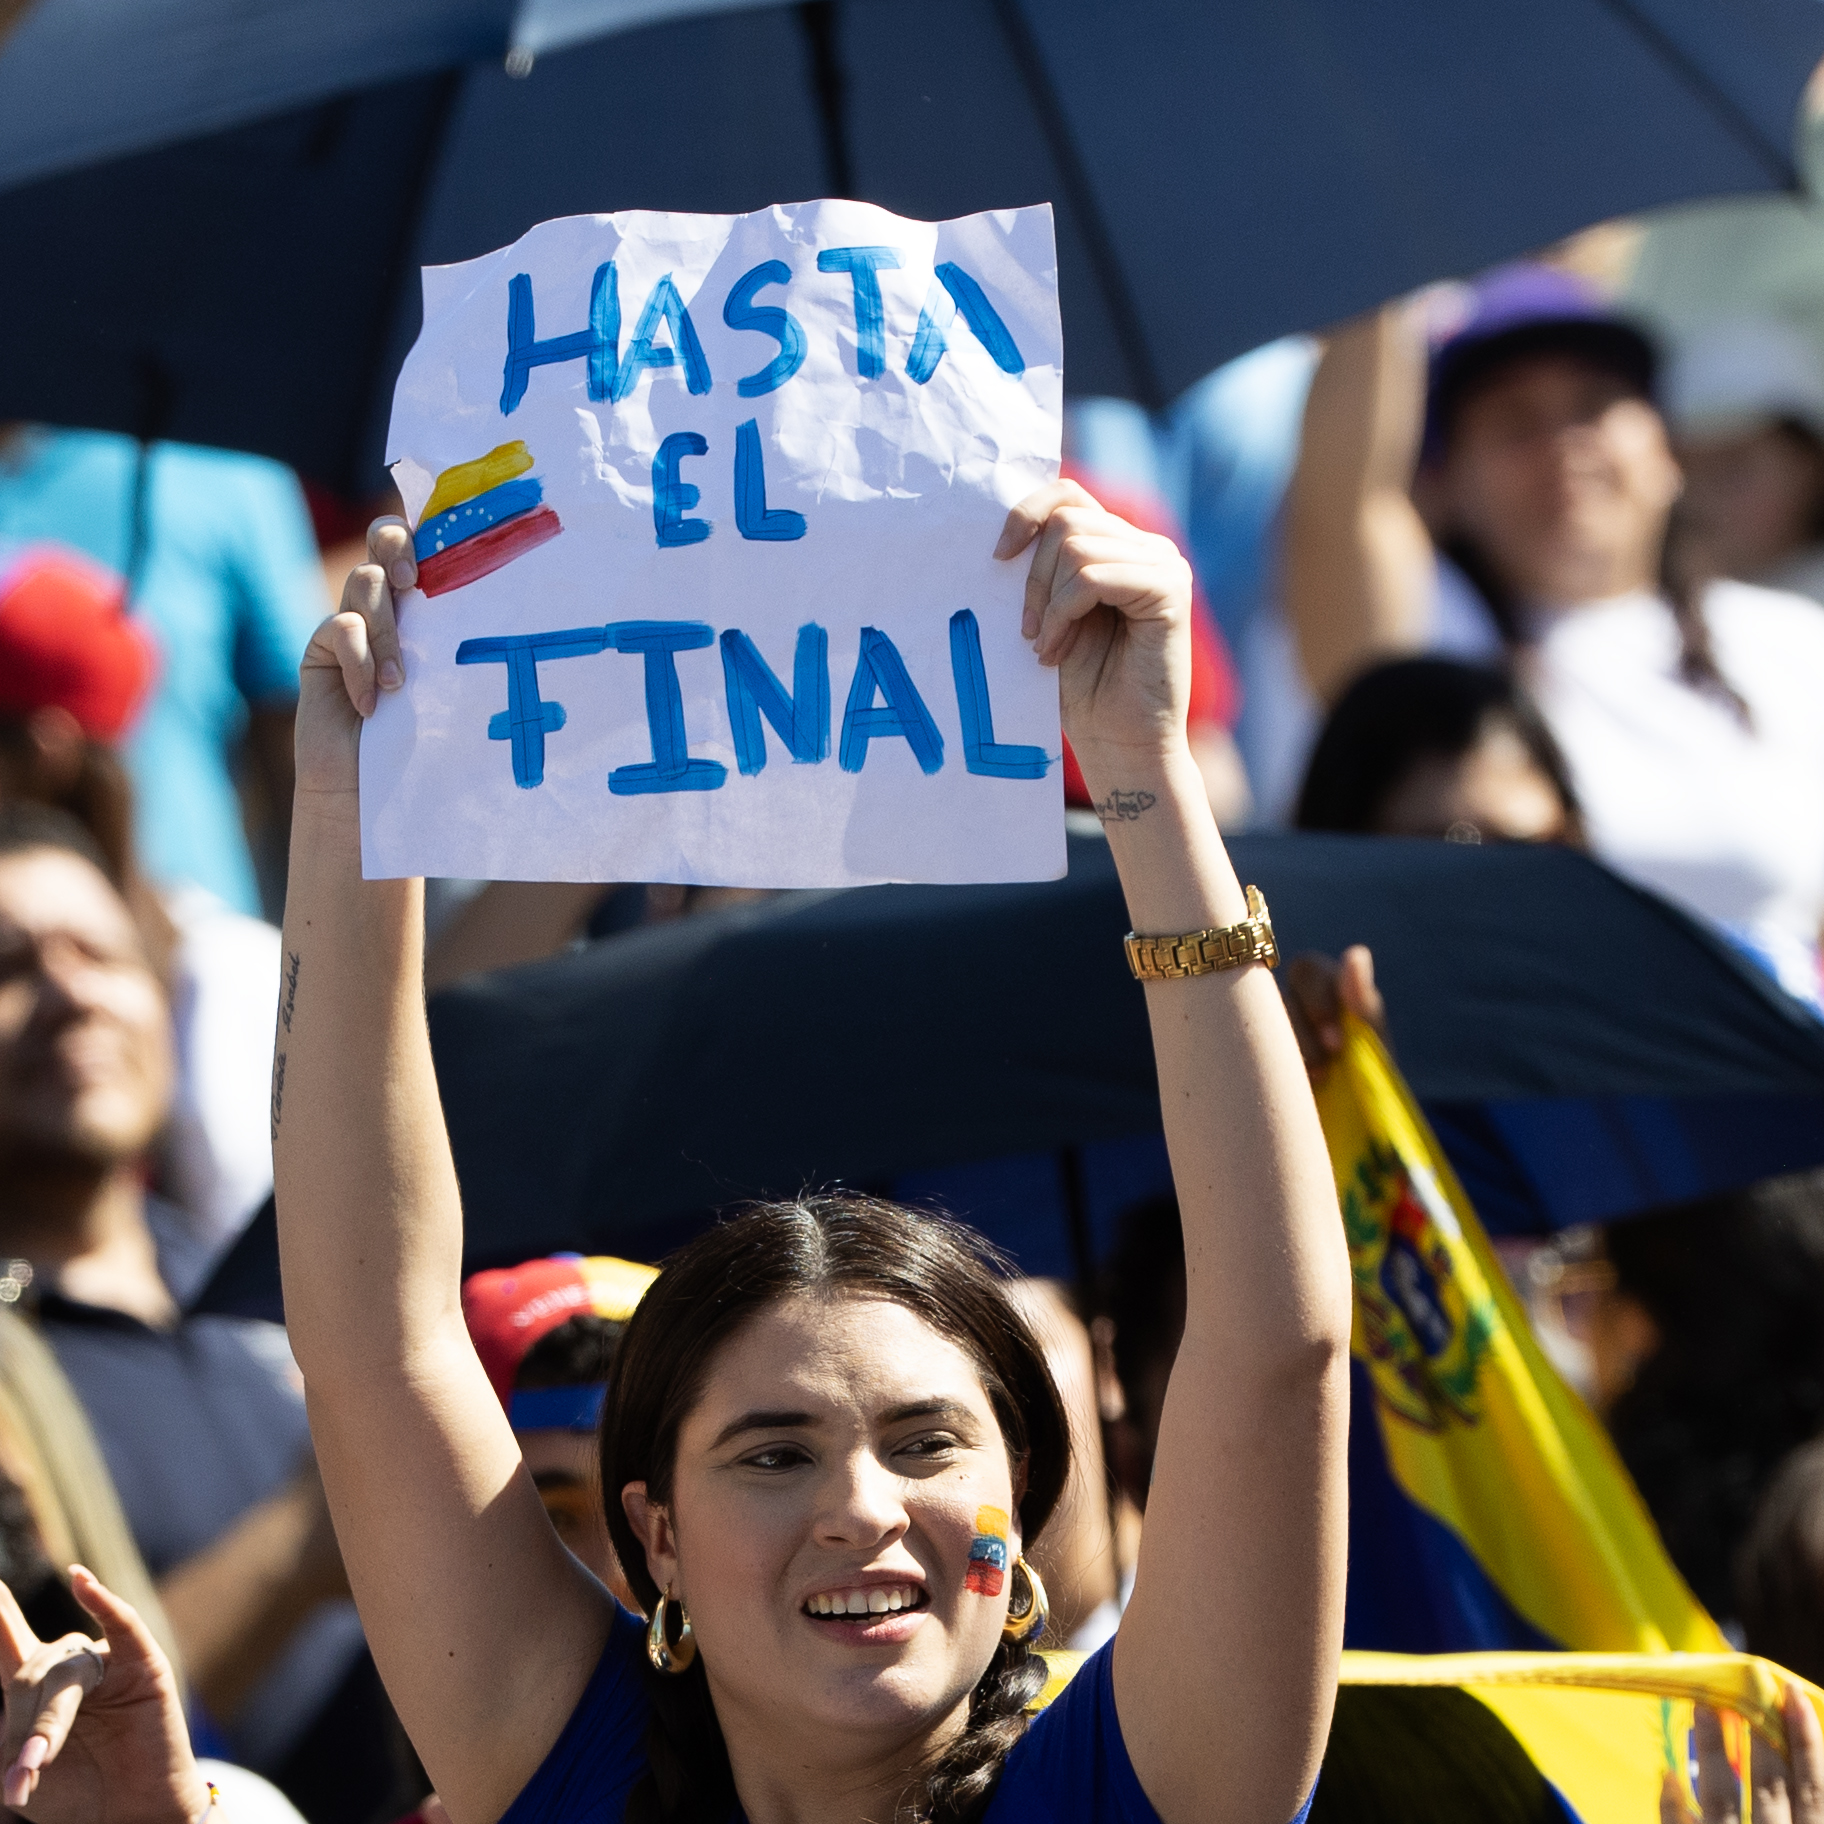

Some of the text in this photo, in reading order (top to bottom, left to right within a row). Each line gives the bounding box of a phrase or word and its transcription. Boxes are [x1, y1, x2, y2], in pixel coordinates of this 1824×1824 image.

[499, 246, 1026, 417] HASTA
[651, 418, 808, 549] EL
[455, 608, 1062, 797] FINAL
